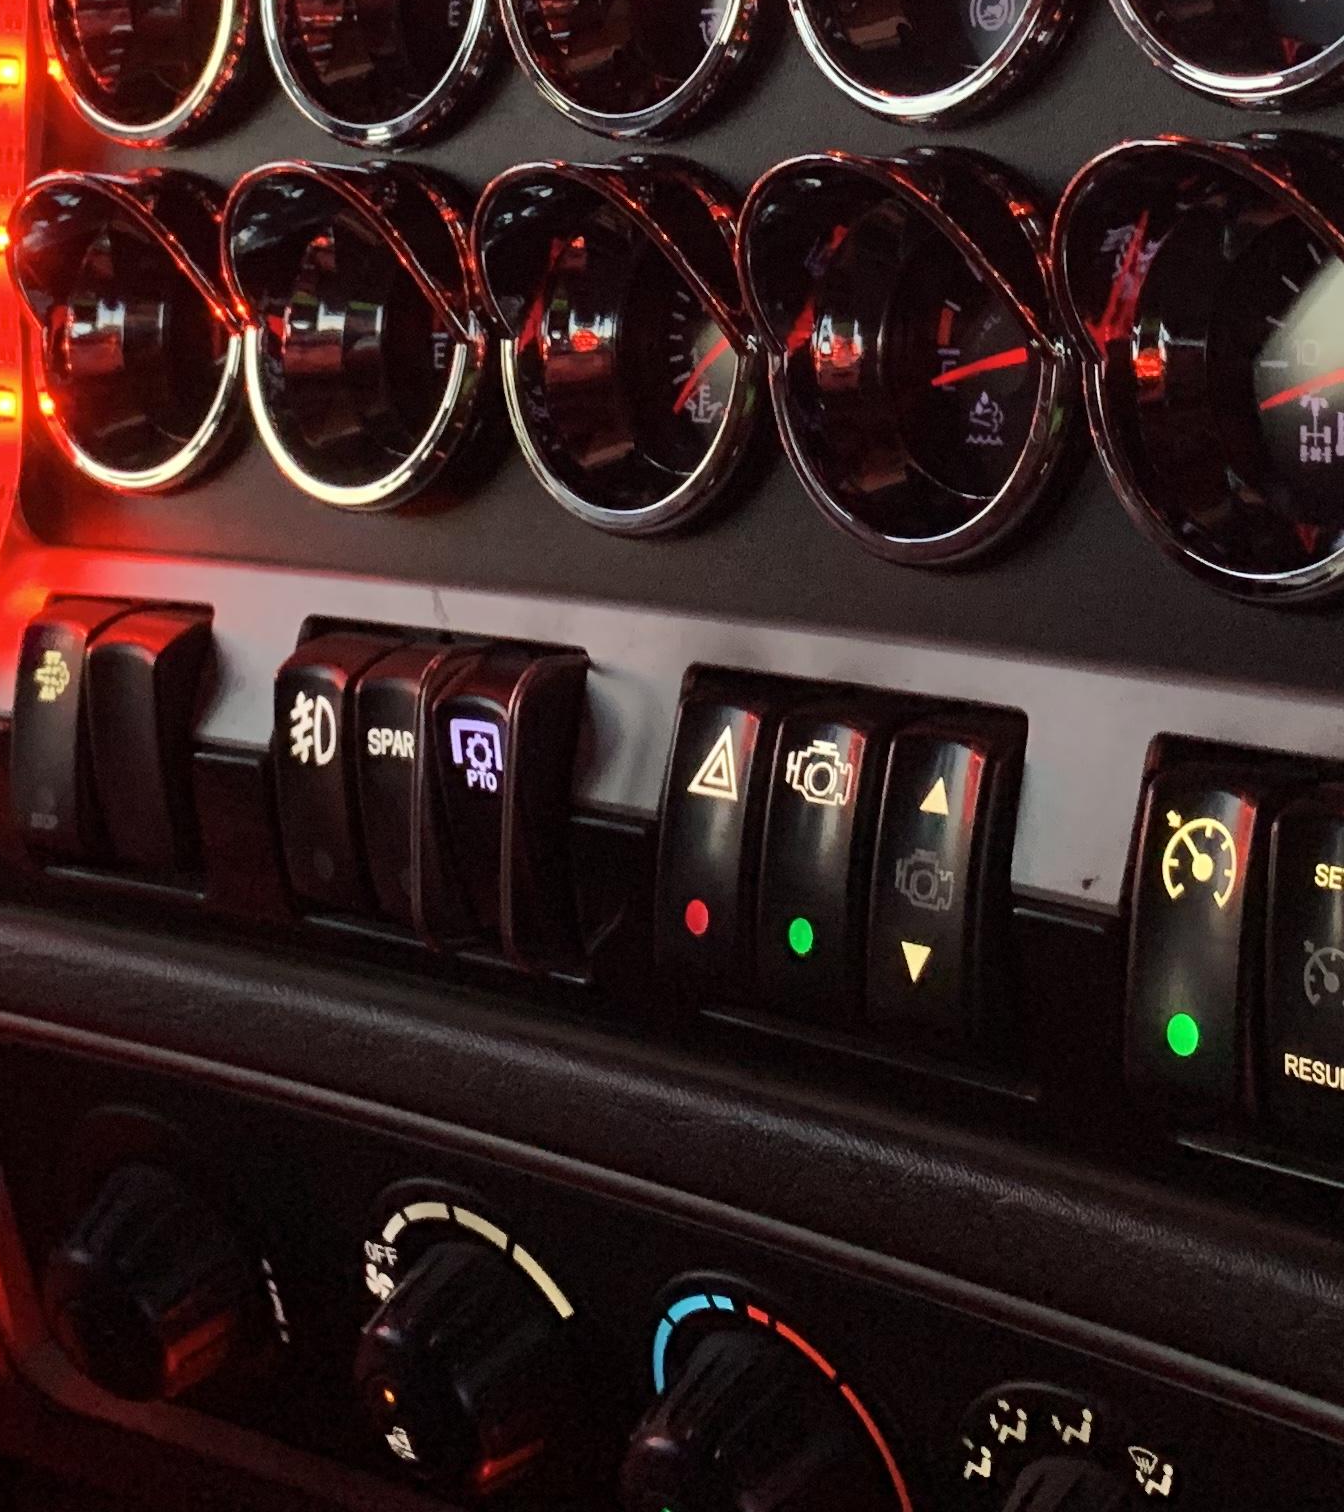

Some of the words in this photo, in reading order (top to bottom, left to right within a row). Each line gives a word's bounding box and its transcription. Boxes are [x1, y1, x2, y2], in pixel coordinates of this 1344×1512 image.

[366, 726, 416, 760] SPAR
[465, 768, 499, 793] PTO
[363, 1239, 399, 1267] OFF
